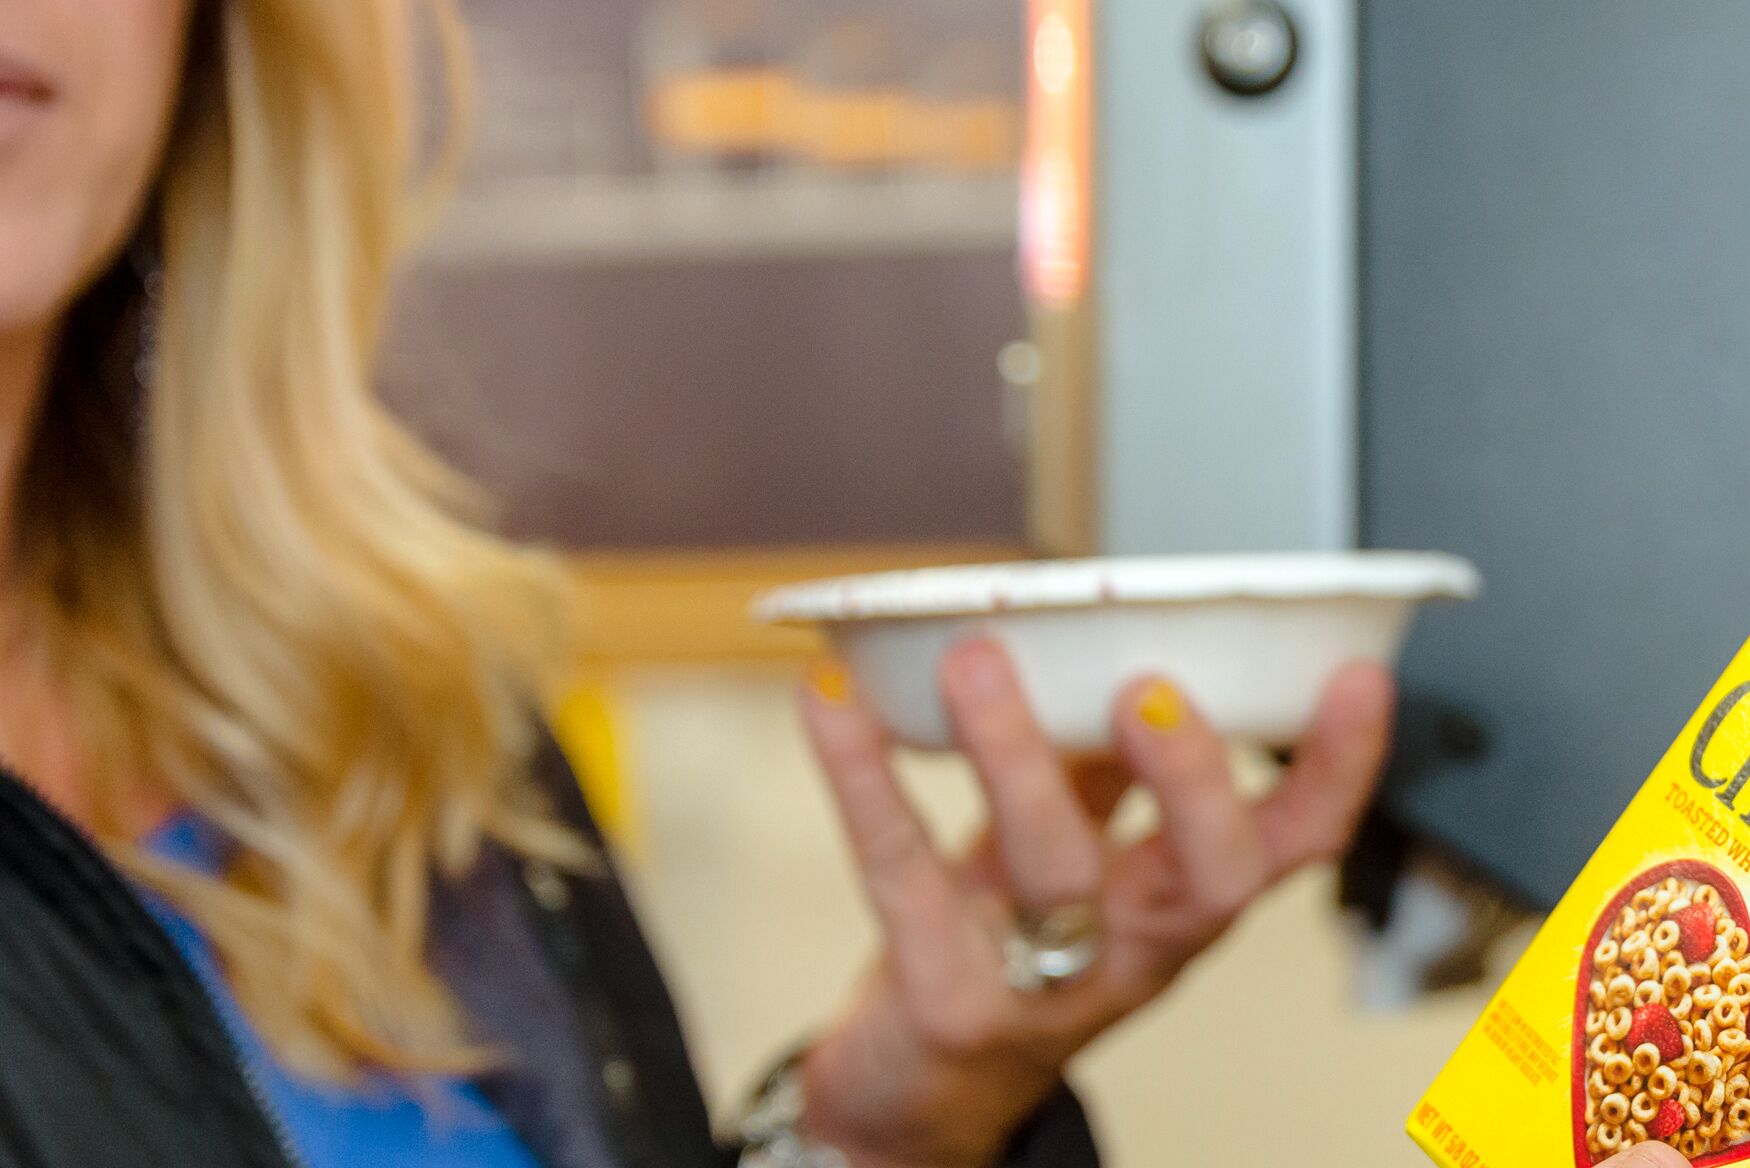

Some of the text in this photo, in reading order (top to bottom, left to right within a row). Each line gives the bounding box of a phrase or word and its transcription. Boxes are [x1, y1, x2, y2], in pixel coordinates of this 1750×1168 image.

[1665, 782, 1732, 848] TOASTED
[1416, 1101, 1439, 1129] NET
[1431, 1118, 1453, 1144] WT
[1444, 1135, 1465, 1161] 5/8
